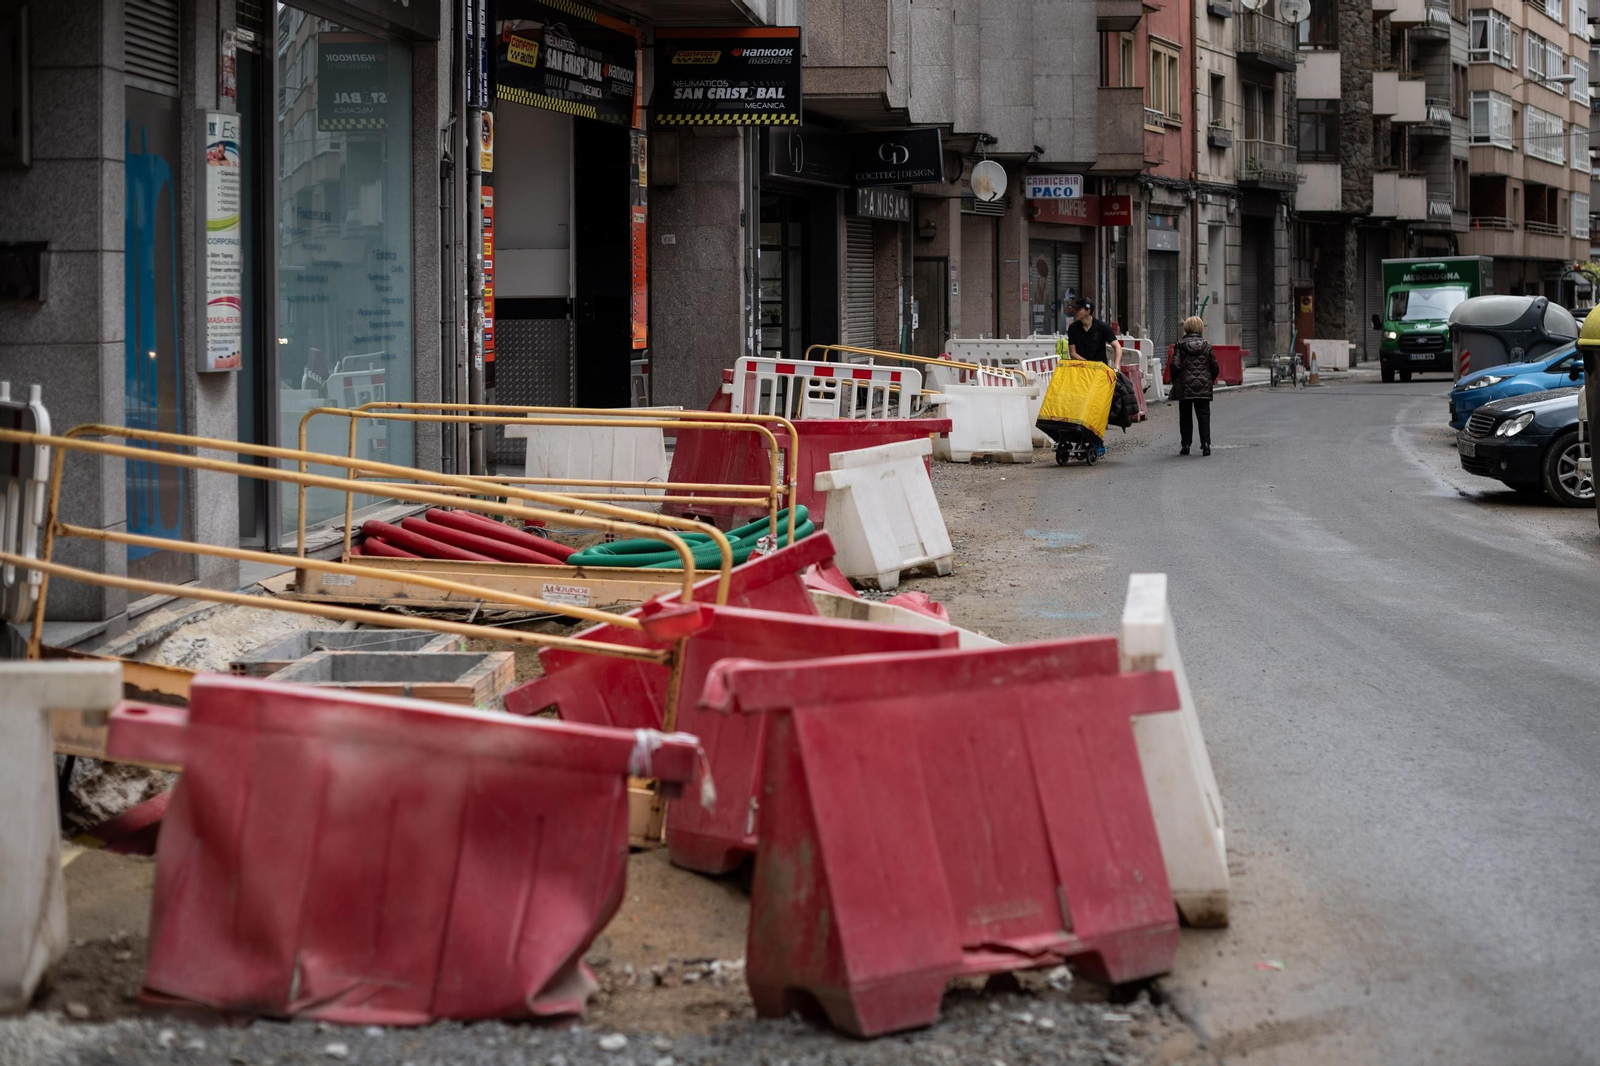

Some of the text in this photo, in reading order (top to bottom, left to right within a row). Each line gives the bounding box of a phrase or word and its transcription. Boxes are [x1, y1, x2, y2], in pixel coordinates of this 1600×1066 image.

[510, 36, 537, 52] CONFORT
[544, 34, 576, 53] NEUMATICOS
[519, 53, 534, 64] auto
[546, 48, 562, 72] SAN
[748, 57, 792, 65] masters
[582, 84, 602, 98] MECANICA
[611, 83, 634, 97] masters
[674, 87, 704, 100] SAN
[855, 169, 935, 181] COCITEC DESIGN
[1027, 177, 1079, 186] CARNICERIA
[1032, 187, 1073, 197] PACO
[877, 192, 899, 219] NOSA
[1058, 199, 1087, 218] MAPFRE
[1403, 272, 1460, 282] MERCADONA
